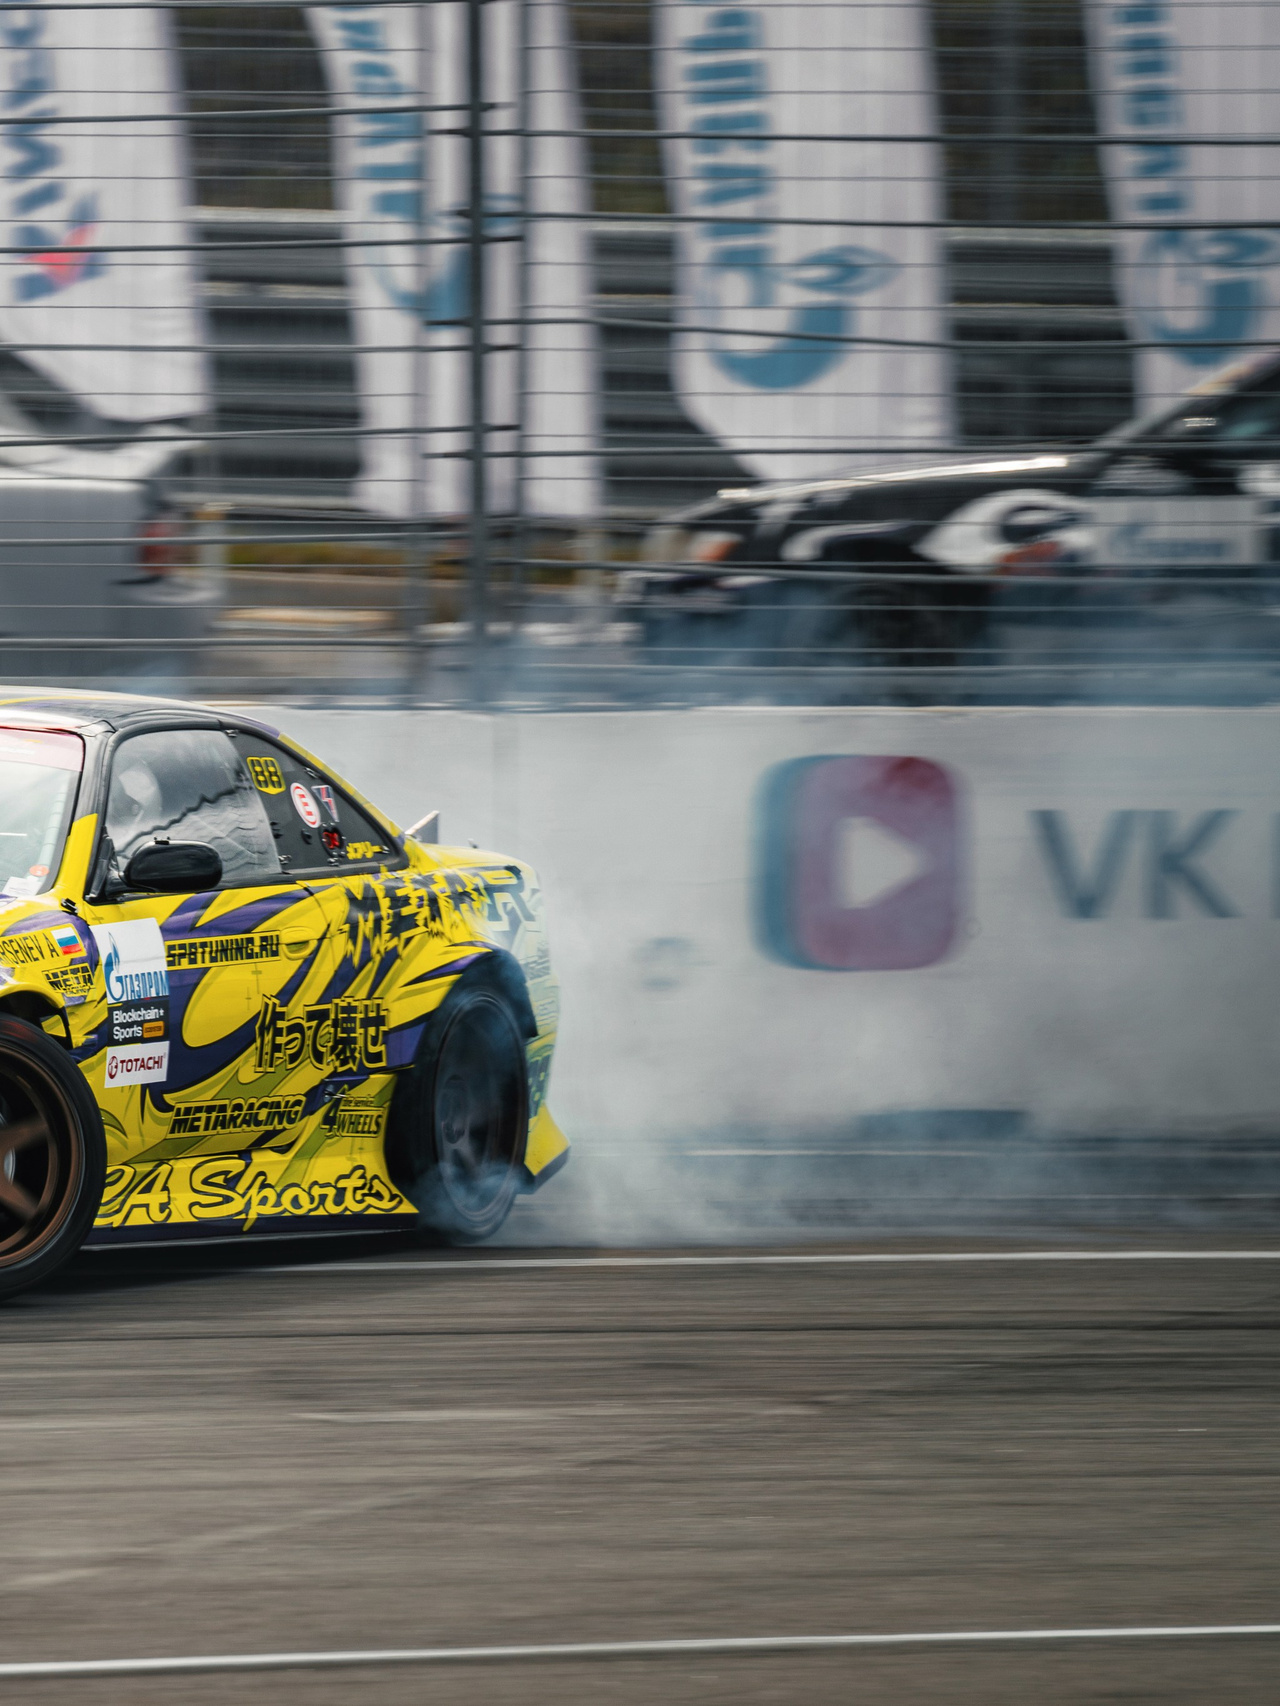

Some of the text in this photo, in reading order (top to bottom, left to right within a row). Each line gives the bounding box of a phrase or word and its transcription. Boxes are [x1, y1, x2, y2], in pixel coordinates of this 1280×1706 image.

[248, 757, 284, 791] 88
[1028, 809, 1240, 919] VK
[43, 932, 60, 958] A
[122, 970, 169, 1001] ГАЗПРОМ
[113, 1024, 143, 1041] Sports
[119, 1055, 164, 1073] TOTACHI
[169, 1099, 304, 1134] METARACING
[189, 1155, 403, 1231] Sports
